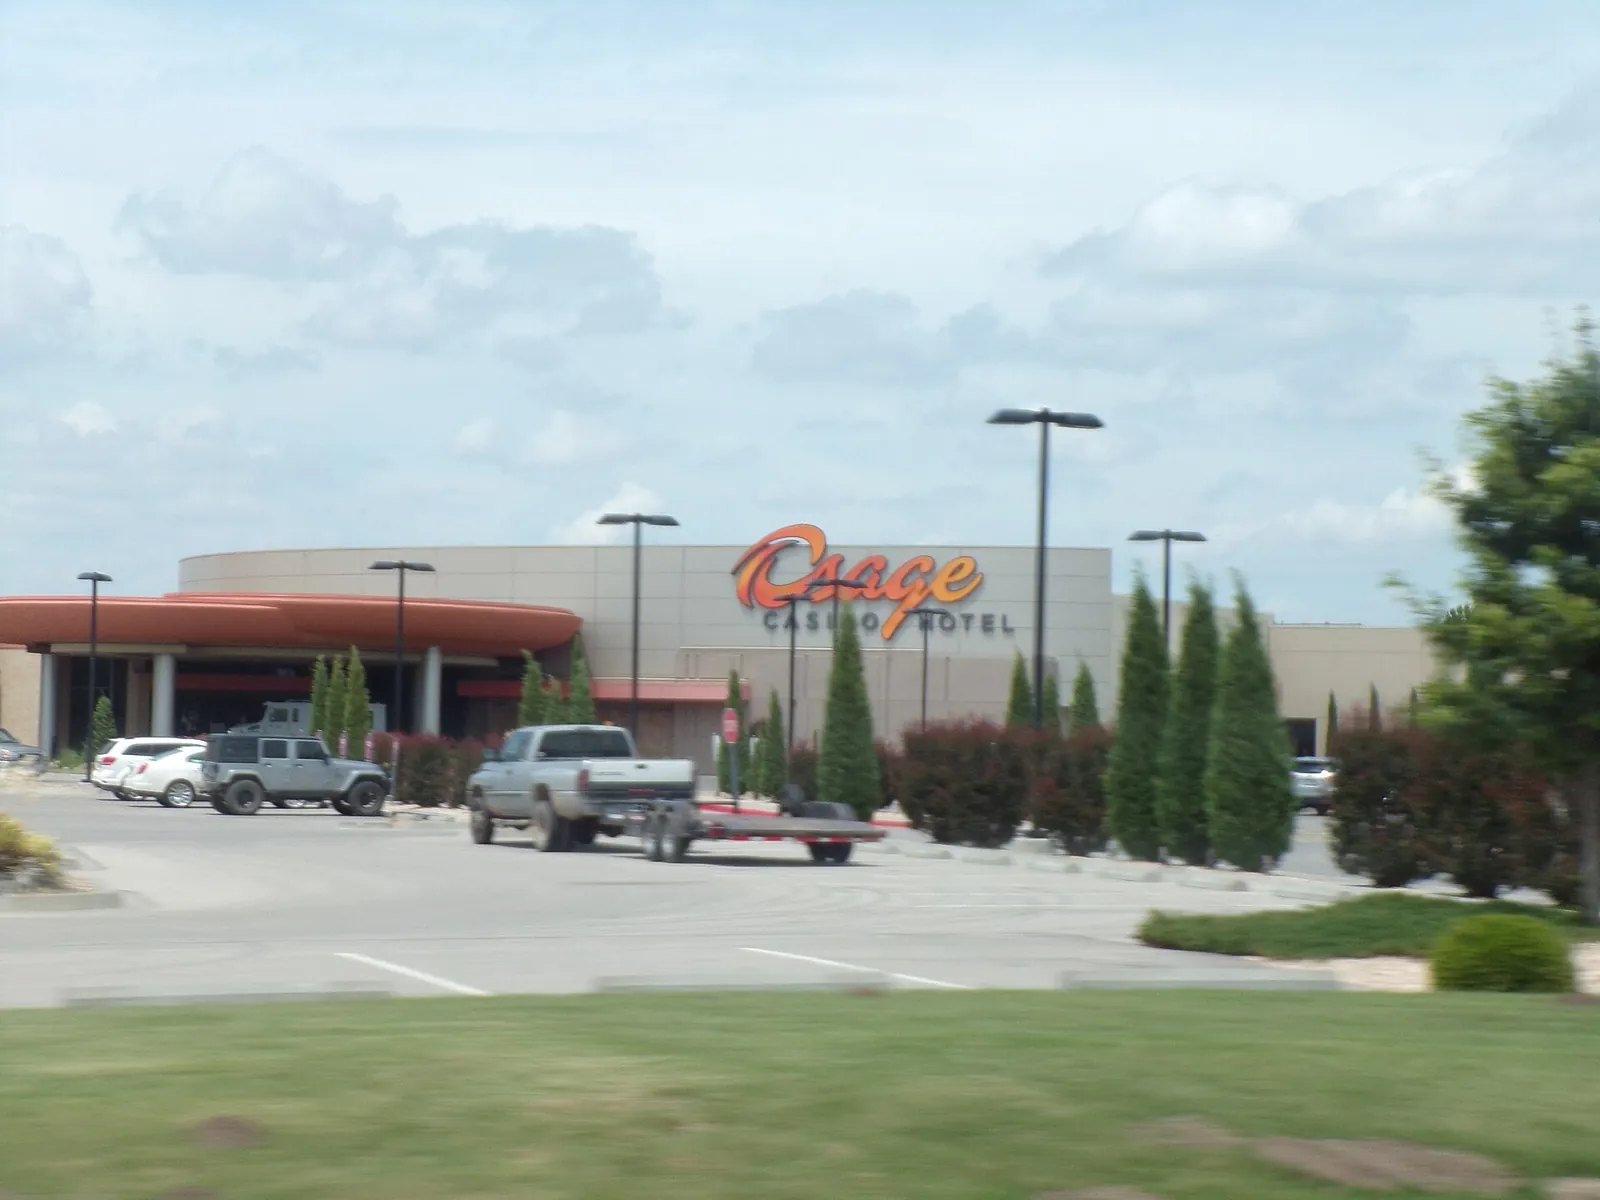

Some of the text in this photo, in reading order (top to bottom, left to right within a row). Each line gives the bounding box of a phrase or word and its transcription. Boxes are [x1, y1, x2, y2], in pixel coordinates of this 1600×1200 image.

[731, 523, 984, 640] Osage
[763, 610, 1015, 633] CASIO HOTEL
